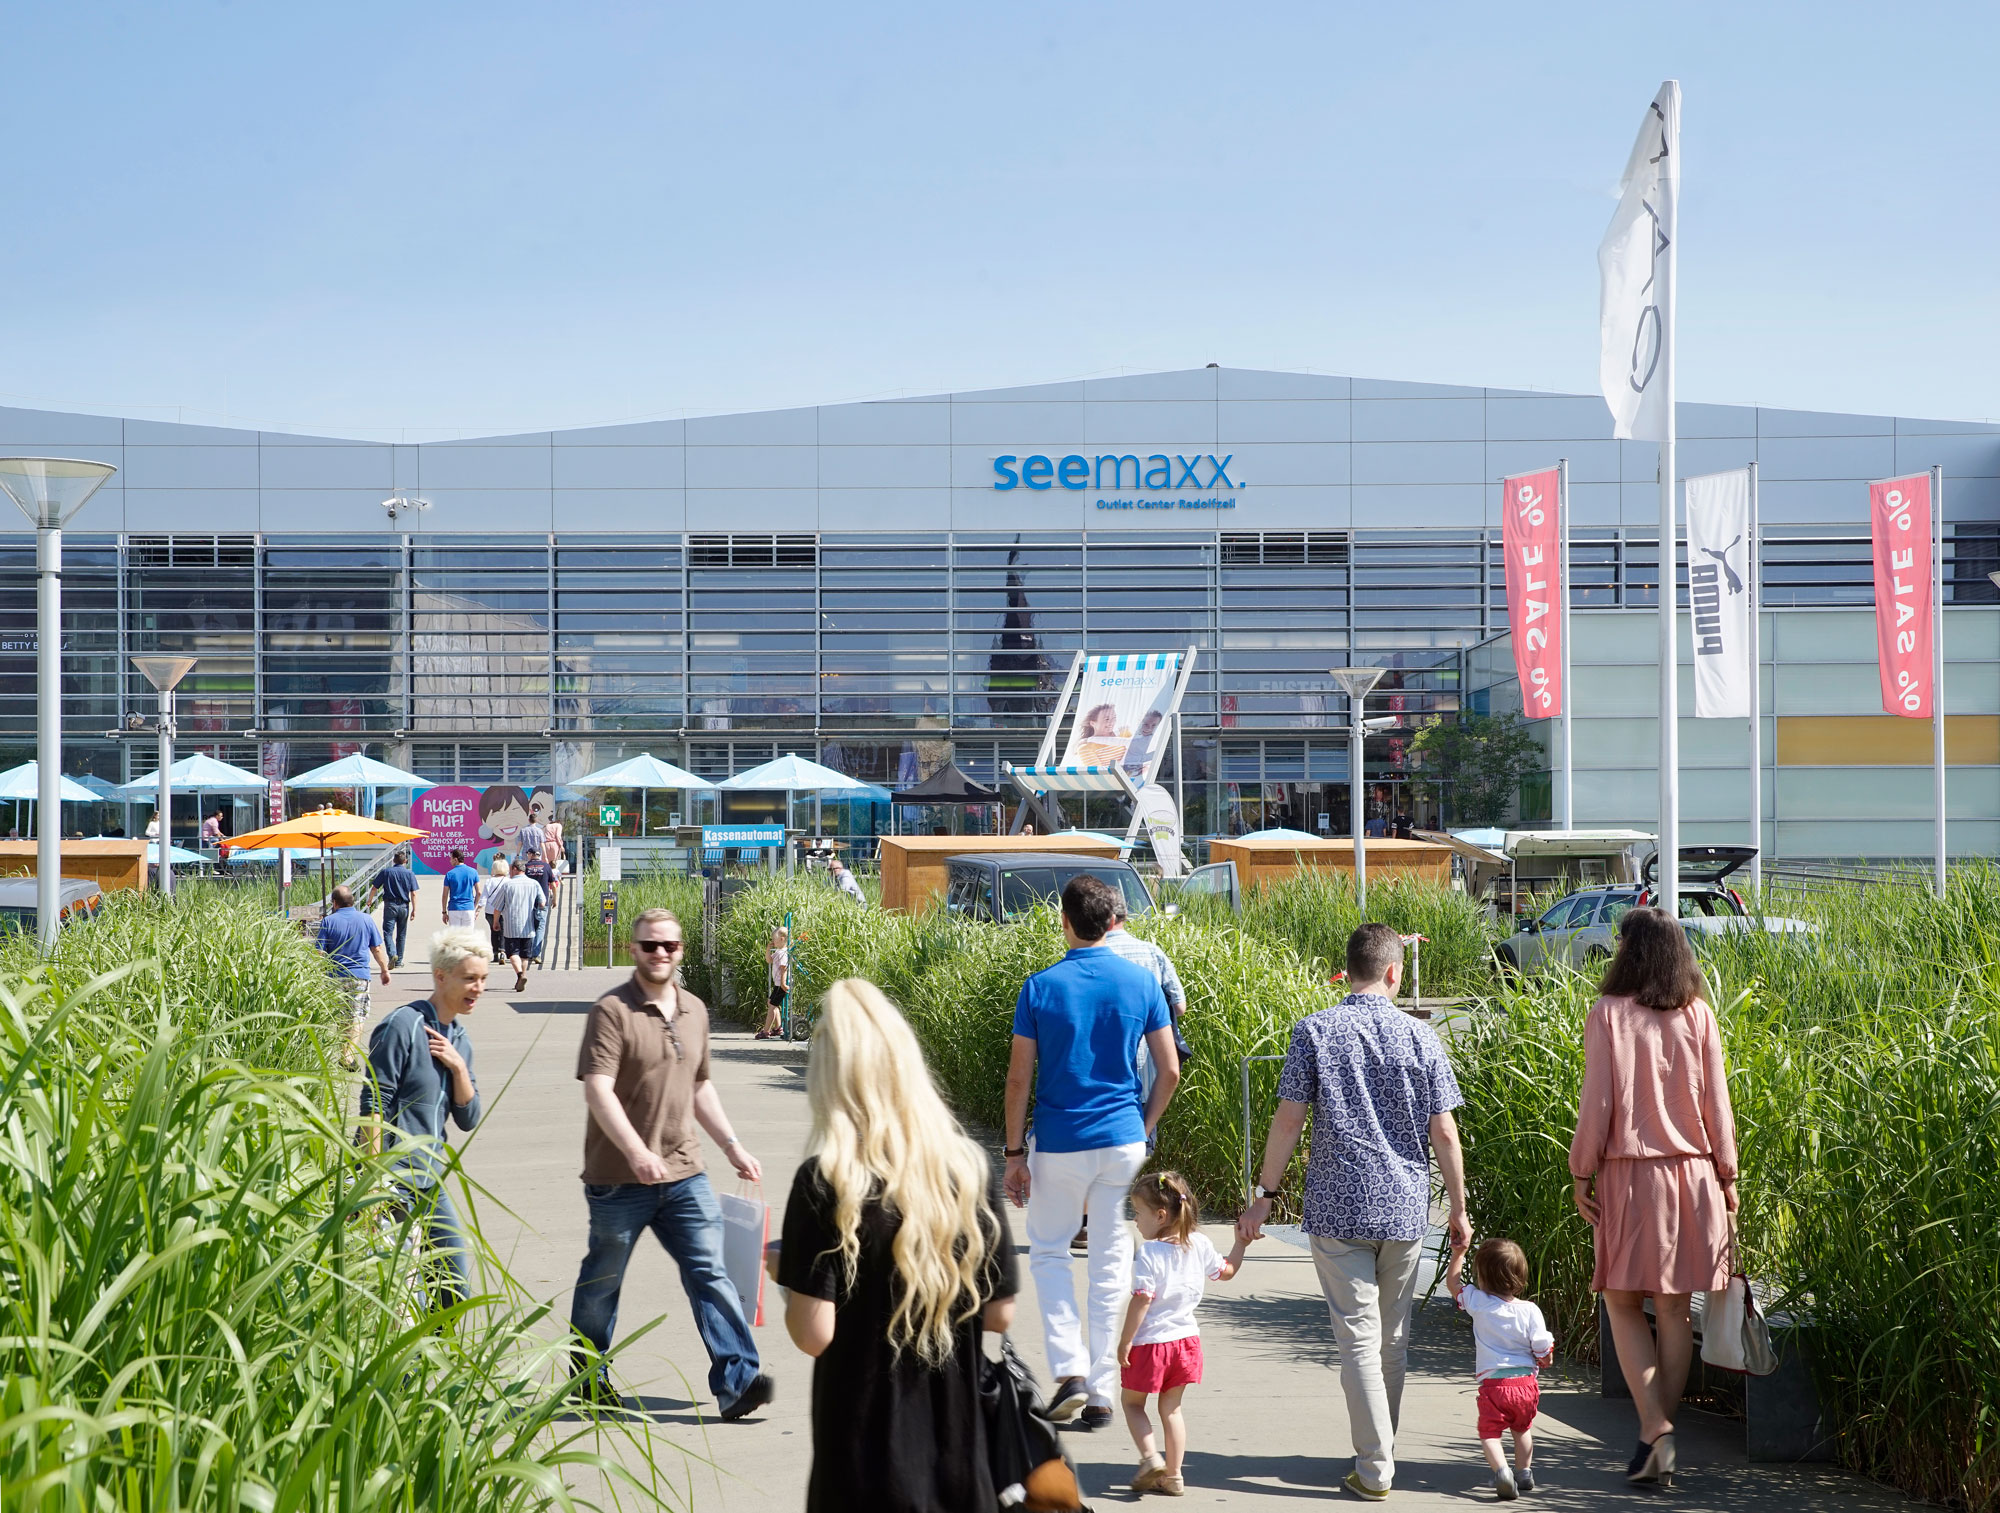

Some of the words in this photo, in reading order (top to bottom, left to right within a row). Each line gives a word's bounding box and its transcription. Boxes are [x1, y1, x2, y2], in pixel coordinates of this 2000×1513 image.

[993, 454, 1246, 490] seemaxx.
[1096, 499, 1134, 510] Outlet
[1137, 499, 1175, 510] Center
[1178, 498, 1236, 509] Radolfzell
[1, 641, 31, 650] BETTY
[423, 799, 473, 814] AUGEN
[432, 814, 464, 828] AUF!
[704, 830, 783, 841] Kassenautomat
